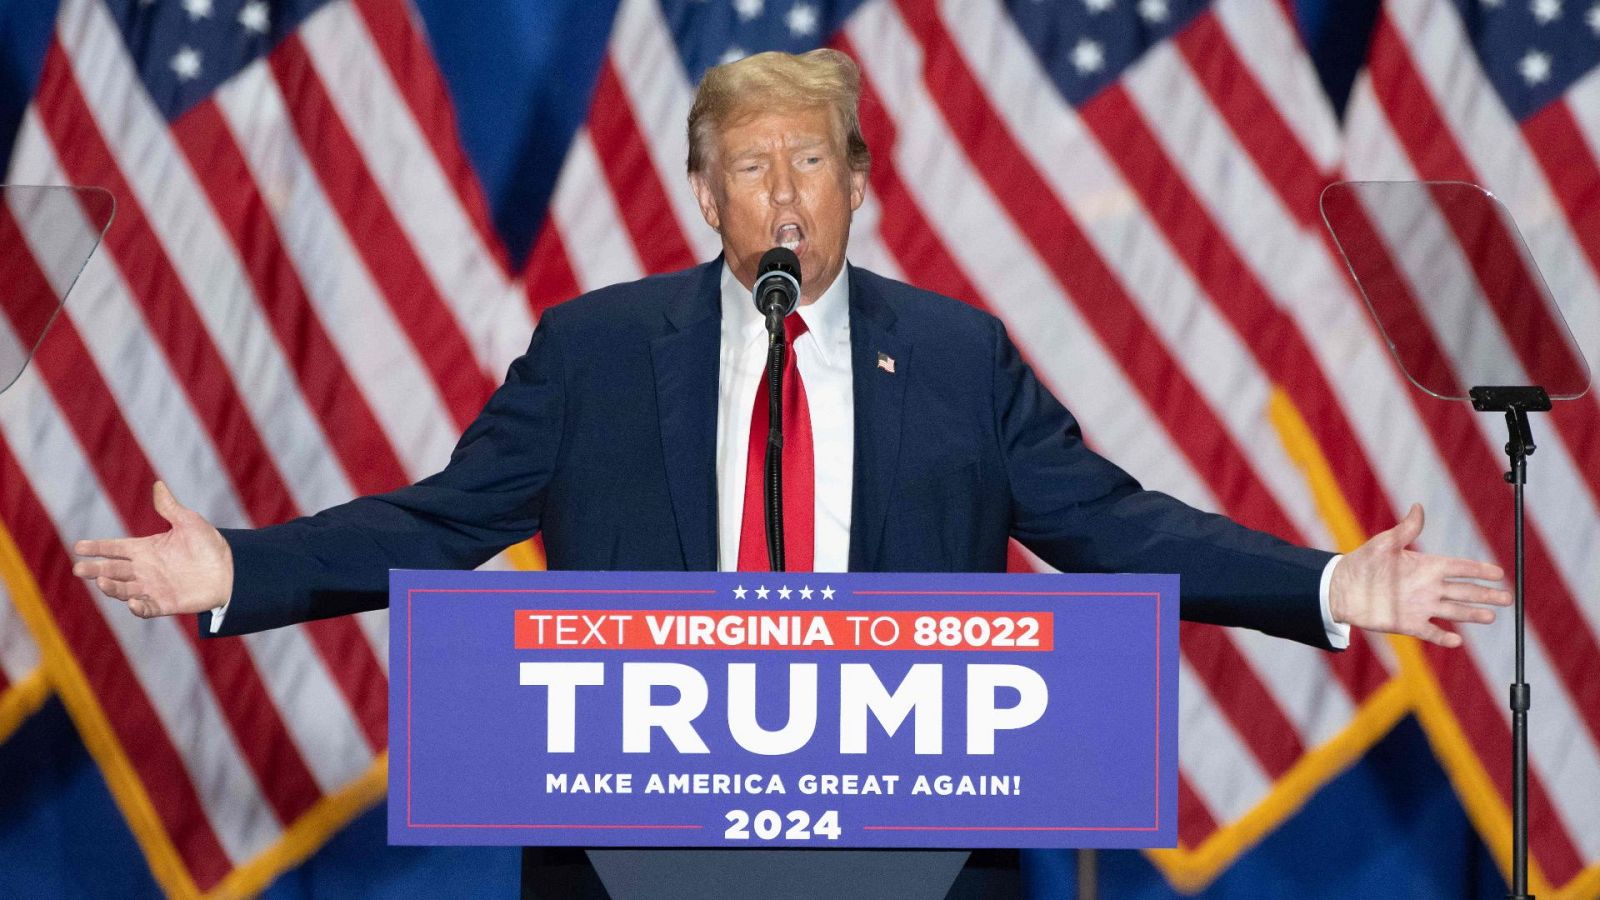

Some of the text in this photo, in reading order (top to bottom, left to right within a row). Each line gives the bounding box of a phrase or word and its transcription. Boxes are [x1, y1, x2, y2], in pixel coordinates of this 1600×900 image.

[529, 614, 1040, 647] TEXT VIRGINIA TO 88022
[519, 661, 1049, 756] TRUMP
[545, 773, 1022, 796] MAKE AMERICA GREAT AGAIN!
[724, 809, 842, 840] 2024
